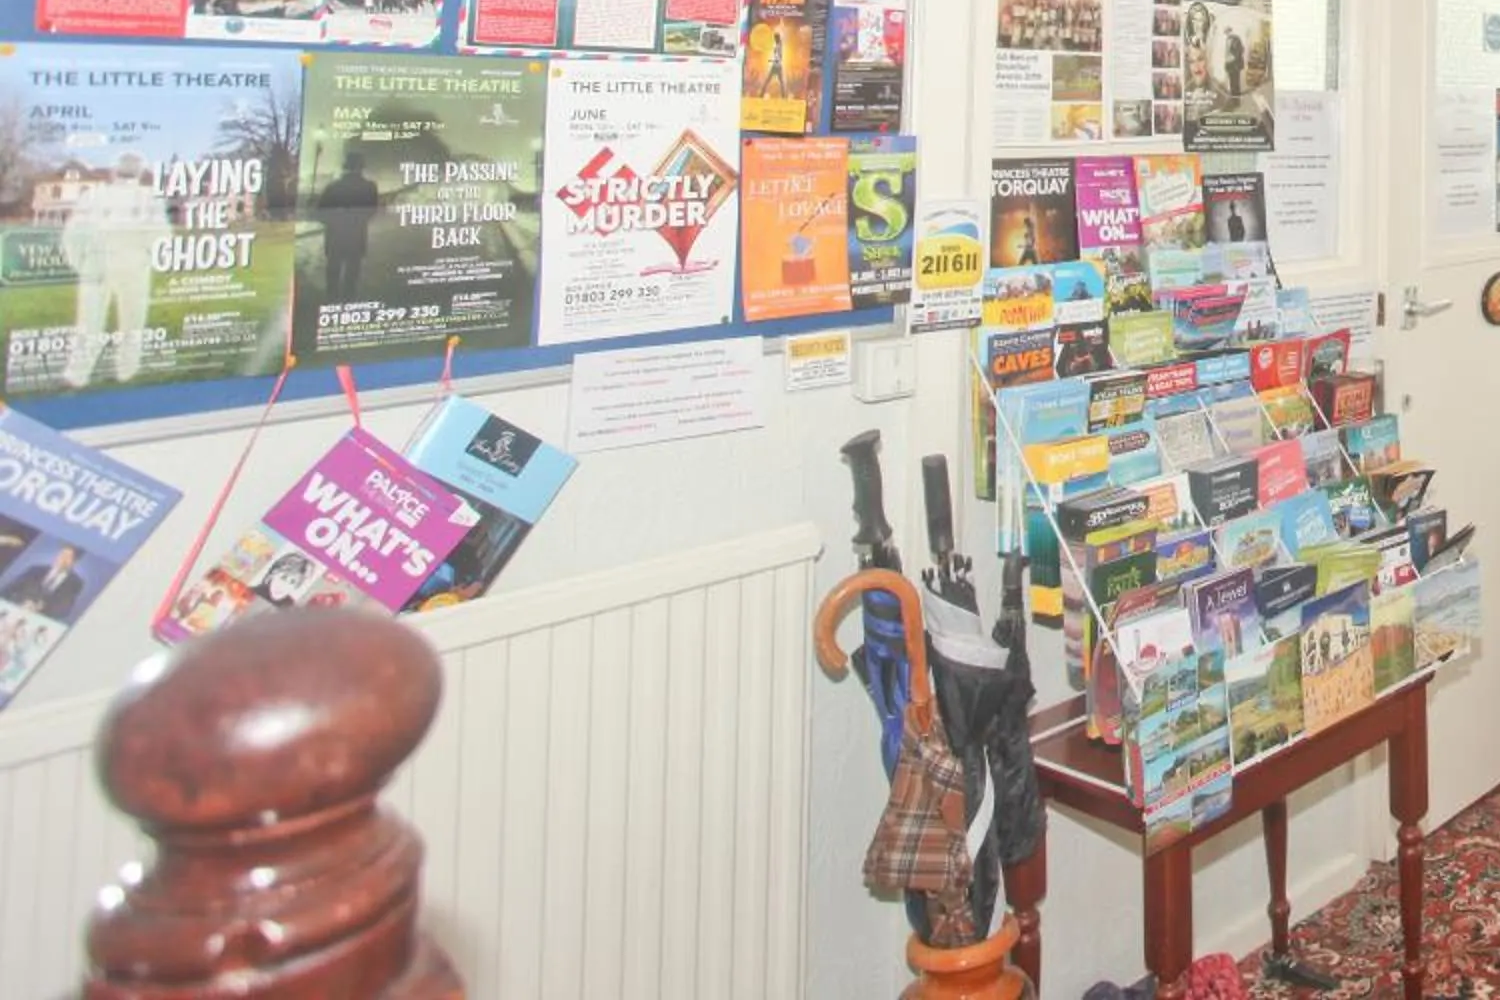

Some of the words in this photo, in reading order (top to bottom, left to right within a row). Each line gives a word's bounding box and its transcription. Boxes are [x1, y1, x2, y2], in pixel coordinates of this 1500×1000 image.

[29, 71, 80, 87] THE
[88, 71, 165, 88] LITTLE
[173, 72, 272, 89] THEATRE
[333, 75, 374, 91] THE
[379, 76, 438, 92] LITTLE
[443, 77, 522, 95] THEATRE
[571, 80, 602, 94] THE
[605, 81, 655, 94] LITTLE
[660, 82, 722, 96] THEATRE
[29, 104, 93, 119] APRIL
[332, 106, 373, 120] MAY
[569, 108, 608, 122] JUNE
[153, 158, 264, 198] LAYING
[400, 161, 440, 185] THE
[444, 160, 520, 183] PASSING
[565, 173, 717, 208] STRICTLY
[991, 178, 1070, 197] TORQUAY
[185, 200, 230, 230] THE
[396, 202, 457, 227] THIRD
[462, 201, 518, 223] FLOOR
[565, 201, 708, 236] MURDER
[852, 170, 908, 243] S
[1081, 208, 1140, 227] WHAT'
[431, 226, 482, 250] BACK
[152, 232, 257, 273] GHOST
[564, 290, 606, 306] 01803
[609, 288, 635, 302] 299
[637, 285, 662, 299] 330
[319, 311, 372, 327] 01803
[375, 308, 406, 322] 299
[410, 305, 441, 319] 330
[993, 347, 1054, 375] CAVES
[0, 430, 81, 480] INCESS
[75, 466, 160, 520] THEATRE
[0, 456, 146, 541] ORQUAY
[301, 471, 435, 577] WHAT'S
